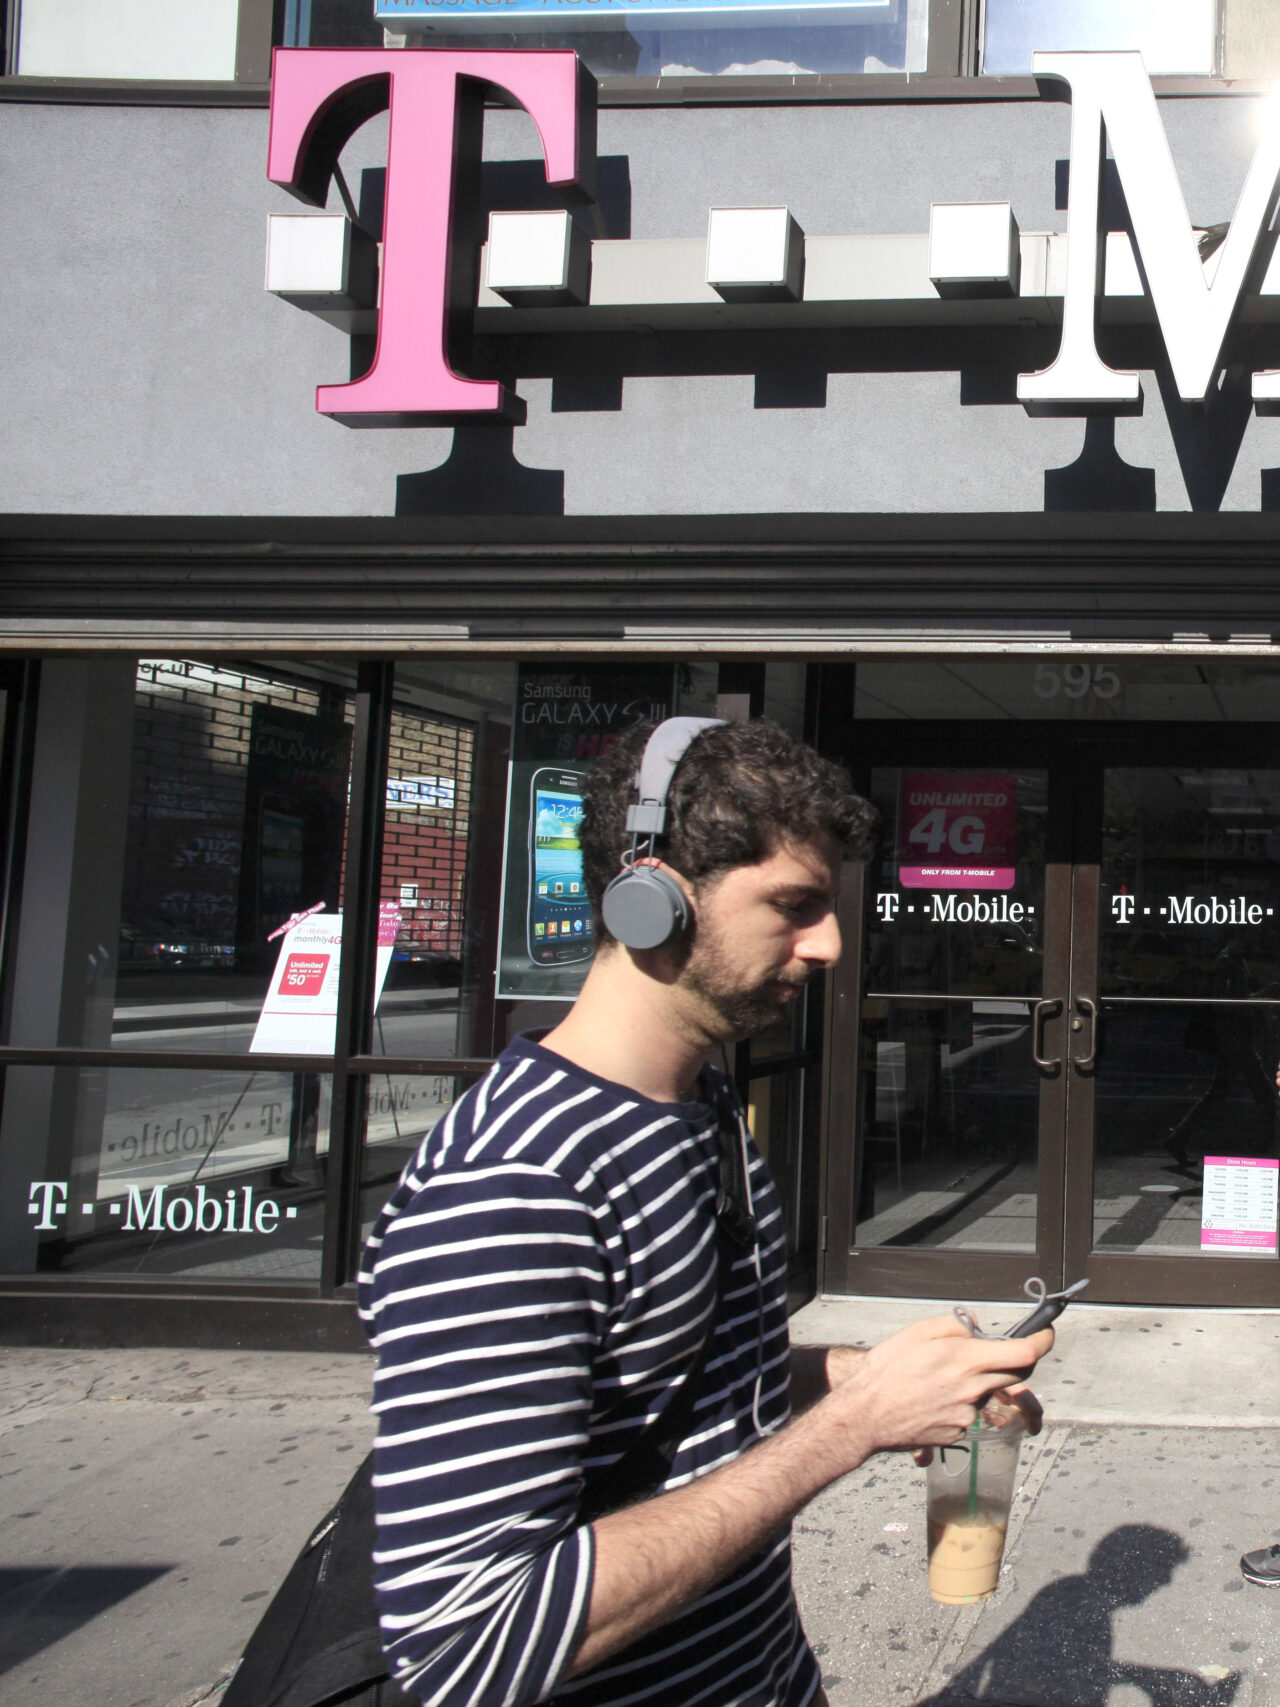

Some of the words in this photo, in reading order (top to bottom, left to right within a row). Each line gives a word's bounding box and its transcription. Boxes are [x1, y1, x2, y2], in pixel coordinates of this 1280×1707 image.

[1033, 663, 1121, 699] 595
[523, 682, 592, 703] Samsung
[521, 702, 618, 725] GALAXY
[909, 792, 1007, 807] UNLIMITED
[908, 808, 986, 855] 4G
[963, 869, 996, 877] T-MOBILE
[290, 961, 324, 969] Unlimited
